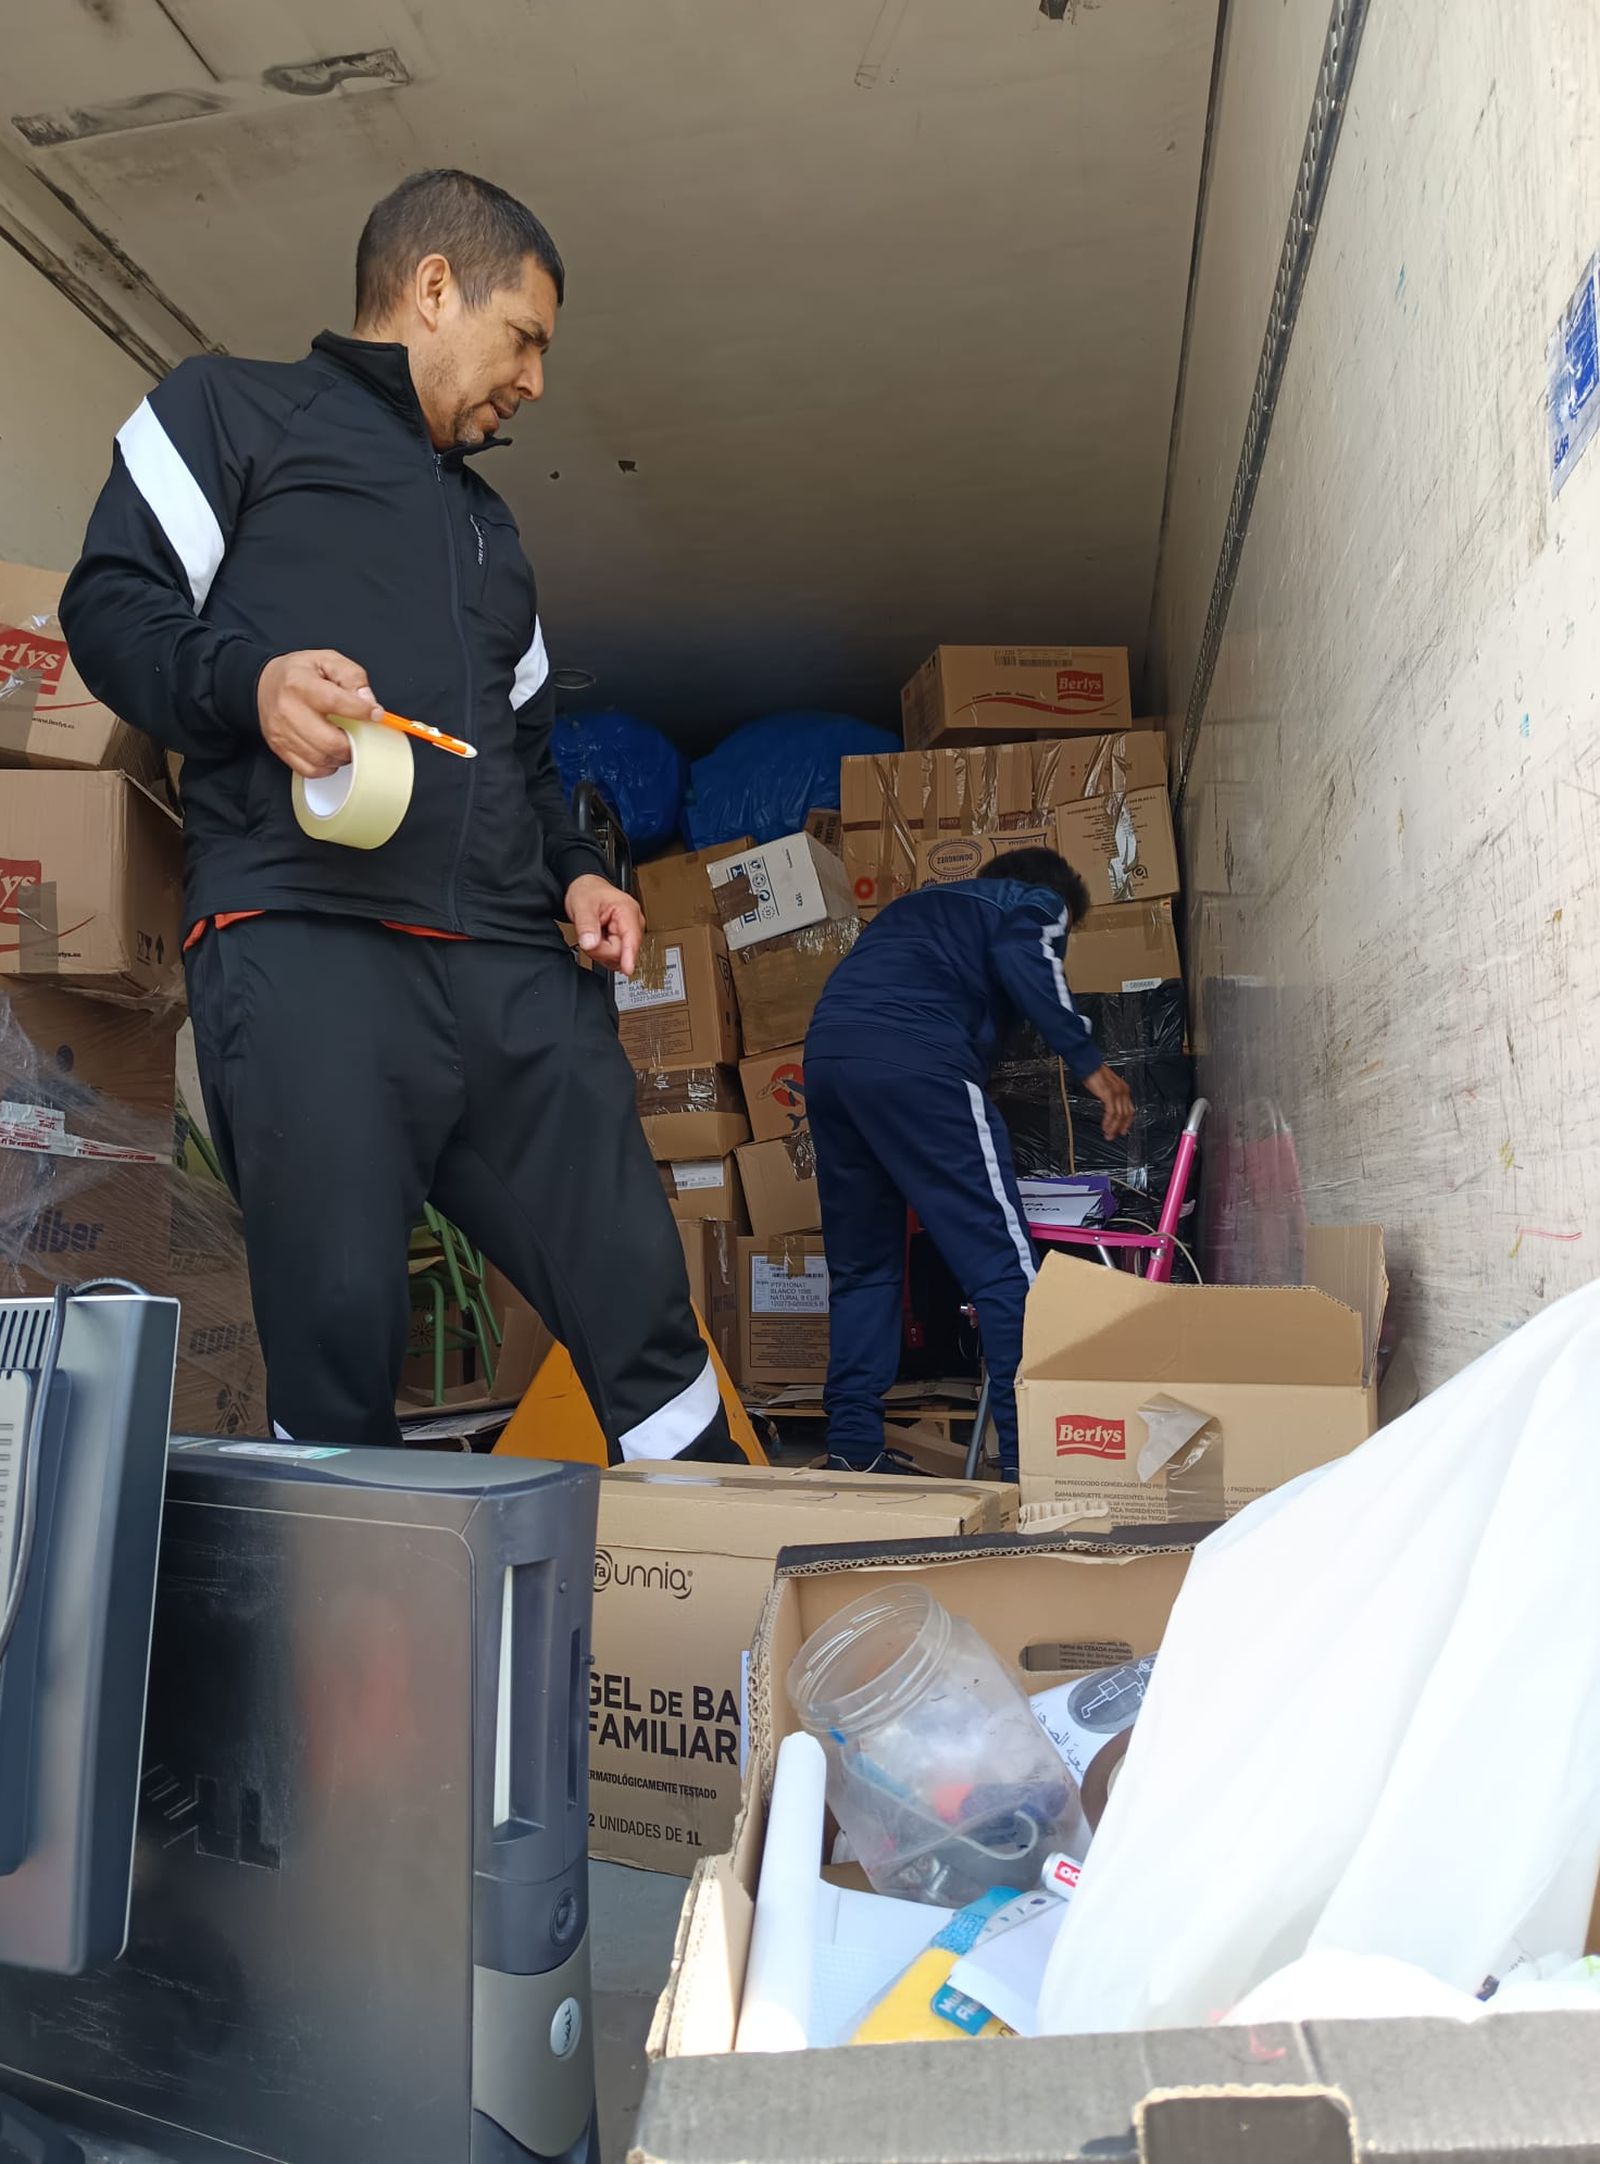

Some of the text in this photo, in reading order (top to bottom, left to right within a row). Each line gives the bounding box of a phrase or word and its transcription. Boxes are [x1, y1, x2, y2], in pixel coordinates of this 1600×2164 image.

[1059, 677, 1102, 694] Berlys
[1058, 1425, 1123, 1451] Berlys
[650, 1688, 683, 1718] DE
[677, 1783, 717, 1800] TESTADO
[600, 1814, 661, 1840] UNIDADES
[665, 1825, 682, 1843] DE
[686, 1829, 703, 1847] 1L
